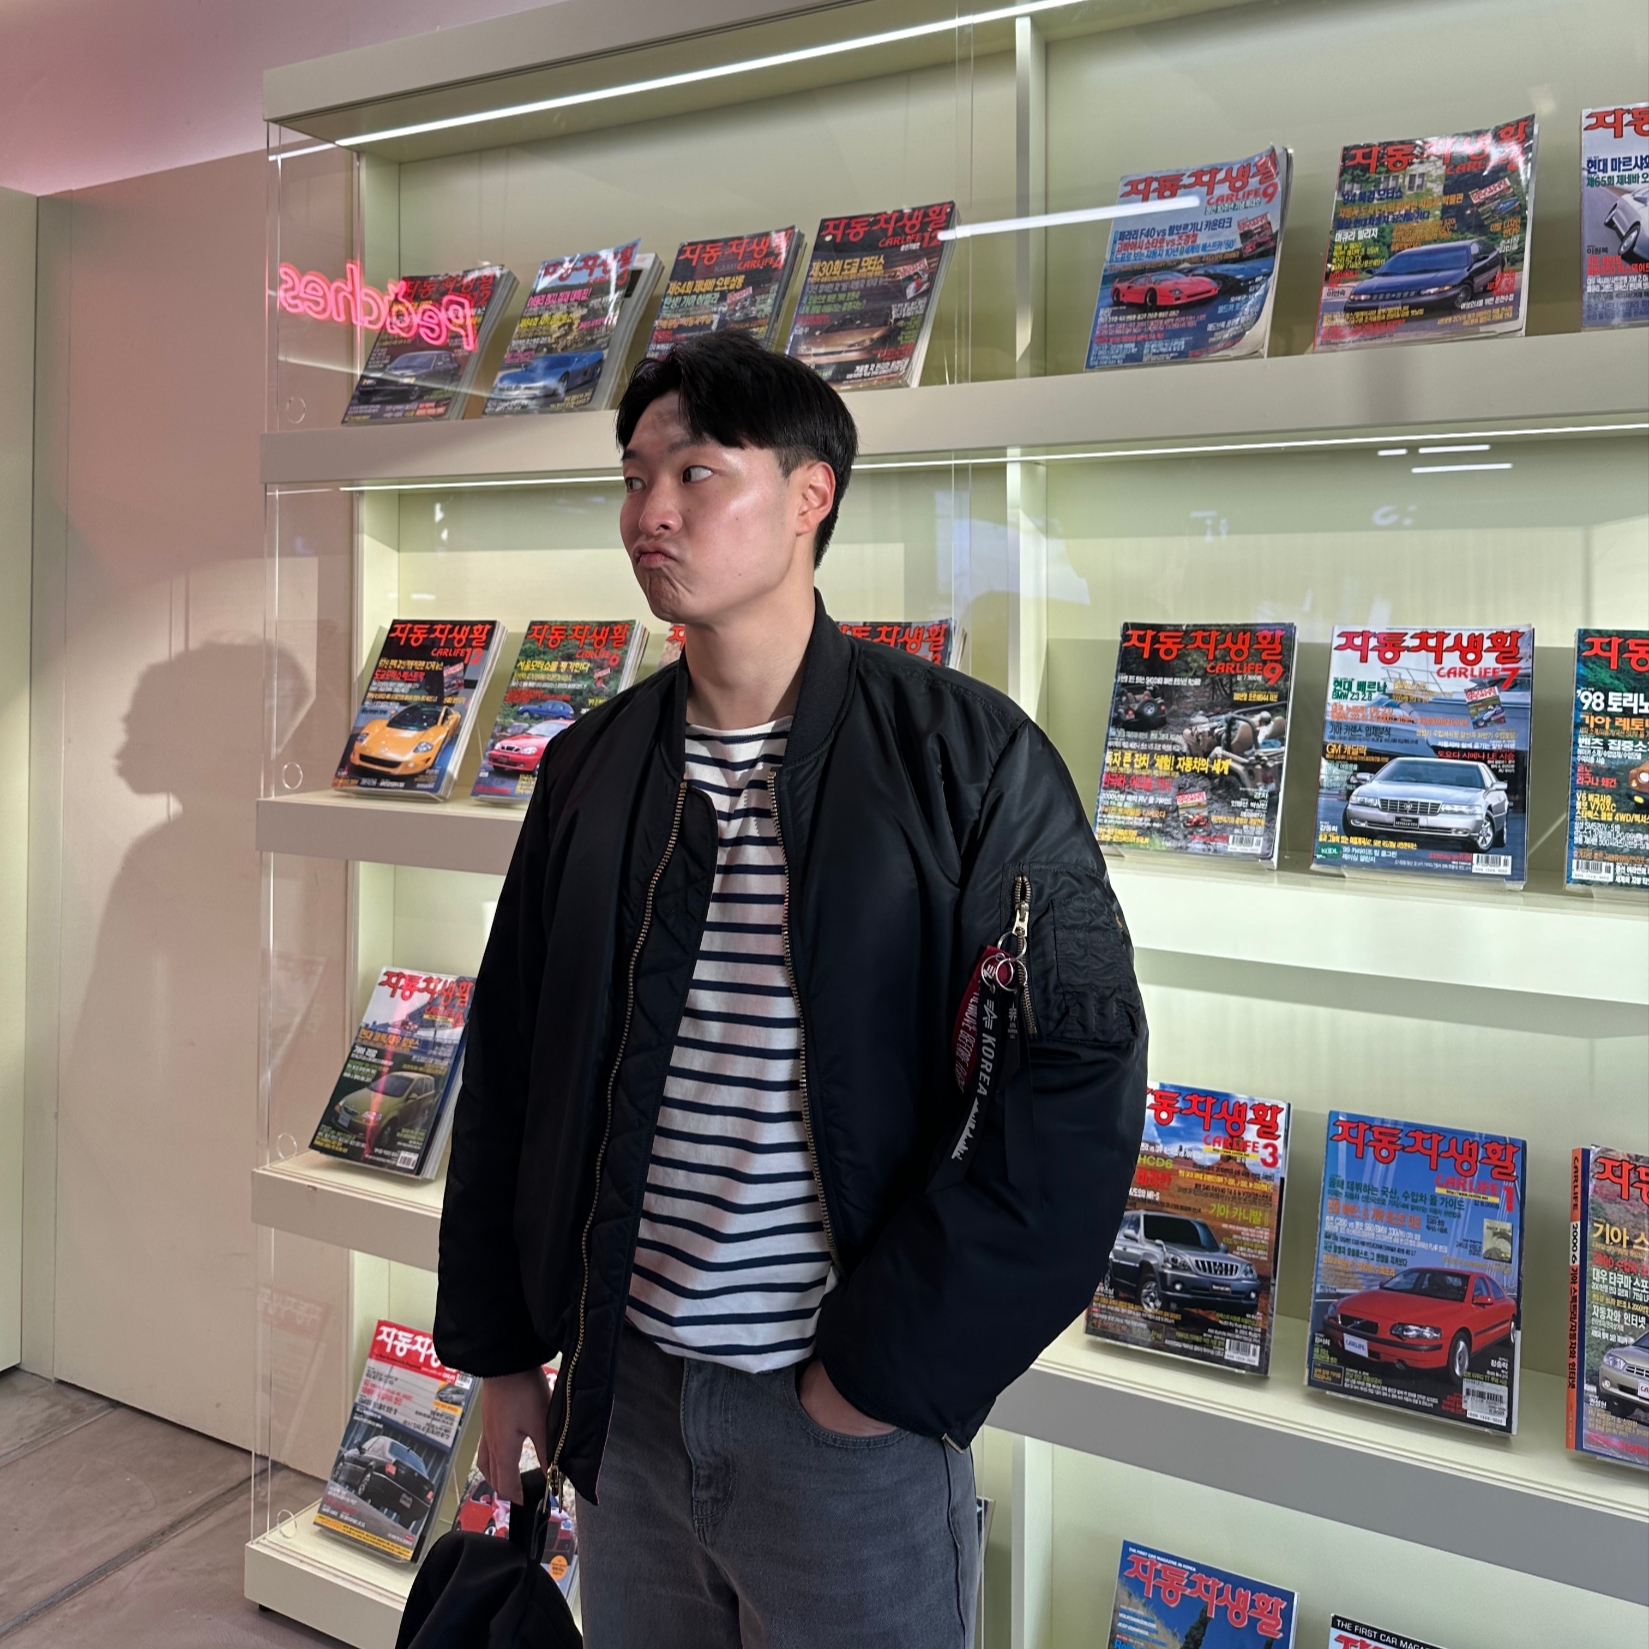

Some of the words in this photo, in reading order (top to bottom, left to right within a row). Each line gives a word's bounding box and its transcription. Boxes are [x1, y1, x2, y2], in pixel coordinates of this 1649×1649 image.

[1120, 150, 1279, 203] 자동차생활
[1586, 158, 1608, 174] 현대
[1587, 174, 1614, 187] 제65회
[1616, 173, 1640, 185] 제네바
[1207, 190, 1260, 206] CARLIFE
[1261, 180, 1280, 204] 9
[1376, 188, 1403, 201] 모터쇼
[820, 203, 952, 243] 자동차생활
[1118, 228, 1140, 241] 페라리
[1139, 226, 1156, 239] F40
[1156, 228, 1167, 238] vs
[1168, 222, 1203, 237] 람보르기니
[1203, 217, 1233, 231] 카운타크
[878, 232, 922, 248] CARLIFE
[922, 229, 942, 248] 12
[1117, 239, 1144, 253] 고바야시
[1166, 238, 1176, 247] vs
[1335, 231, 1356, 243] 머큐리
[810, 259, 842, 278] 제30회
[389, 623, 492, 648] 자동차생활
[526, 623, 630, 649] 자동차생활
[840, 624, 949, 654] 동차생활
[1122, 629, 1287, 662] 자동차생활
[430, 647, 466, 658] CARLIFE
[463, 647, 484, 666] 12
[1334, 630, 1526, 666] 자동차생활
[608, 652, 620, 668] 6
[1206, 661, 1263, 675] CARLIFE
[1262, 662, 1284, 686] 9
[1435, 667, 1501, 679] CARLIFE
[1500, 666, 1522, 690] 7
[1331, 691, 1349, 700] BMW
[1349, 692, 1360, 701] Z3
[1360, 692, 1373, 701] 2.8
[1333, 679, 1353, 693] 현대
[1356, 680, 1388, 695] 베르나
[1576, 689, 1605, 711] '98
[1329, 724, 1343, 735] 기아
[1345, 724, 1363, 736] 카렌스
[1365, 725, 1391, 738] 입체분석
[1580, 713, 1611, 730] 기아
[1325, 742, 1341, 754] GM
[1342, 745, 1367, 757] 캐딜락
[1499, 751, 1515, 760] 시승
[1578, 737, 1604, 750] 벤츠
[1607, 739, 1649, 752] 집중소
[1122, 751, 1132, 765] 큰
[1134, 752, 1149, 768] 잔치
[1176, 756, 1209, 773] 자동차의
[1576, 776, 1600, 787] 라구나
[1576, 791, 1587, 801] V6
[1587, 793, 1612, 804] 비교시승
[1590, 801, 1617, 812] V70XC
[377, 970, 475, 1007] 자동차생활
[976, 1032, 997, 1097] KOREA
[1147, 1086, 1284, 1140] 동차생활
[1137, 1154, 1174, 1169] HCD6
[1203, 1133, 1260, 1154] CARLIFE
[1260, 1142, 1280, 1168] 3
[1330, 1119, 1520, 1181] 자동차생활
[1434, 1173, 1499, 1197] CARLIFE
[1503, 1185, 1515, 1212] 1
[1572, 1155, 1580, 1211] CARLIFE
[1346, 1180, 1379, 1196] 데뷔하는
[1381, 1186, 1400, 1201] 국산,
[1401, 1189, 1427, 1204] 수입차
[1439, 1195, 1465, 1211] 가이드
[1209, 1203, 1230, 1219] 기아
[1232, 1205, 1263, 1225] 카니발
[1592, 1221, 1629, 1249] 기아
[1592, 1251, 1615, 1270] 2000
[1592, 1267, 1608, 1284] 대우
[1608, 1271, 1632, 1290] 타쿠마
[1591, 1304, 1621, 1324] 자동차와
[1623, 1312, 1646, 1330] 인터넷
[376, 1324, 458, 1374] 자동차생
[1567, 1362, 1577, 1389] 인터넷
[1124, 1554, 1287, 1640] 자동차생활
[1336, 1619, 1353, 1631] THE
[1354, 1625, 1378, 1639] FIRST
[1380, 1633, 1398, 1646] CAR
